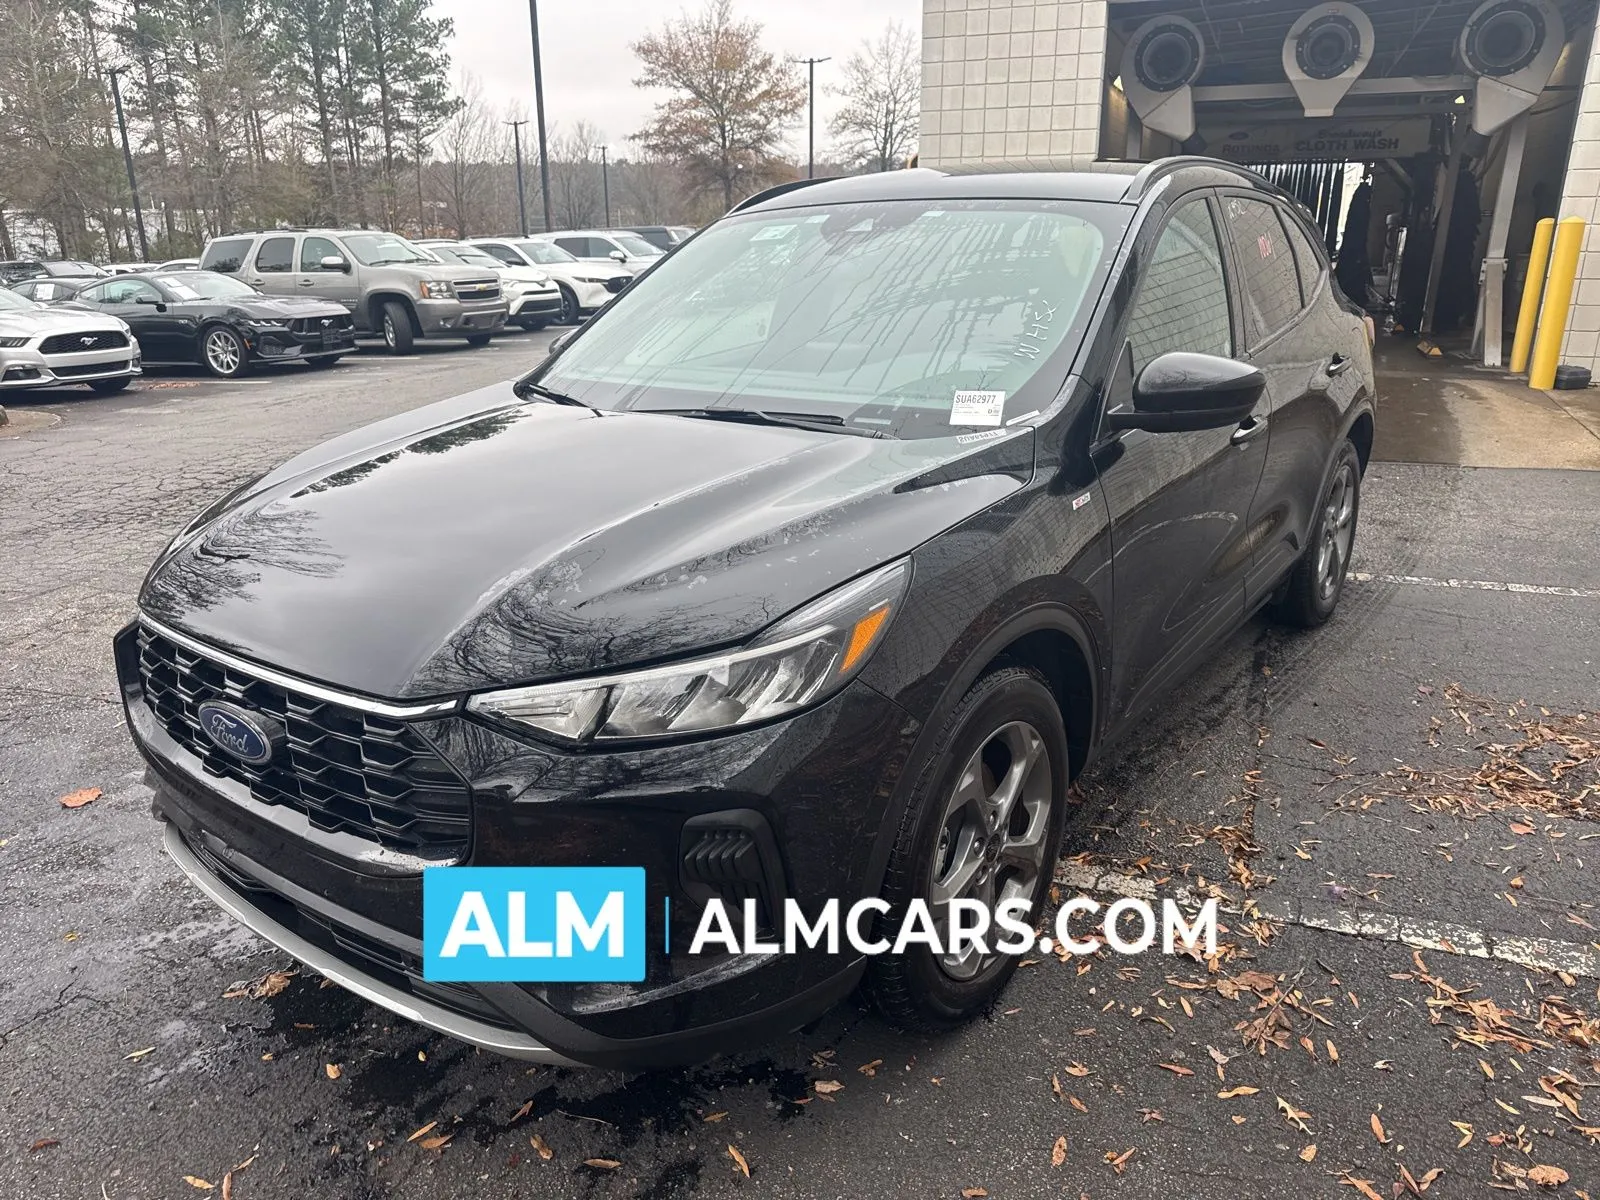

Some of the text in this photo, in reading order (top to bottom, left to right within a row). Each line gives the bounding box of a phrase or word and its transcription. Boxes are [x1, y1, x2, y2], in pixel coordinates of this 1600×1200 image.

[1295, 137, 1400, 152] CLOTH WASH
[955, 394, 997, 404] SUA62977
[210, 714, 249, 753] Ford
